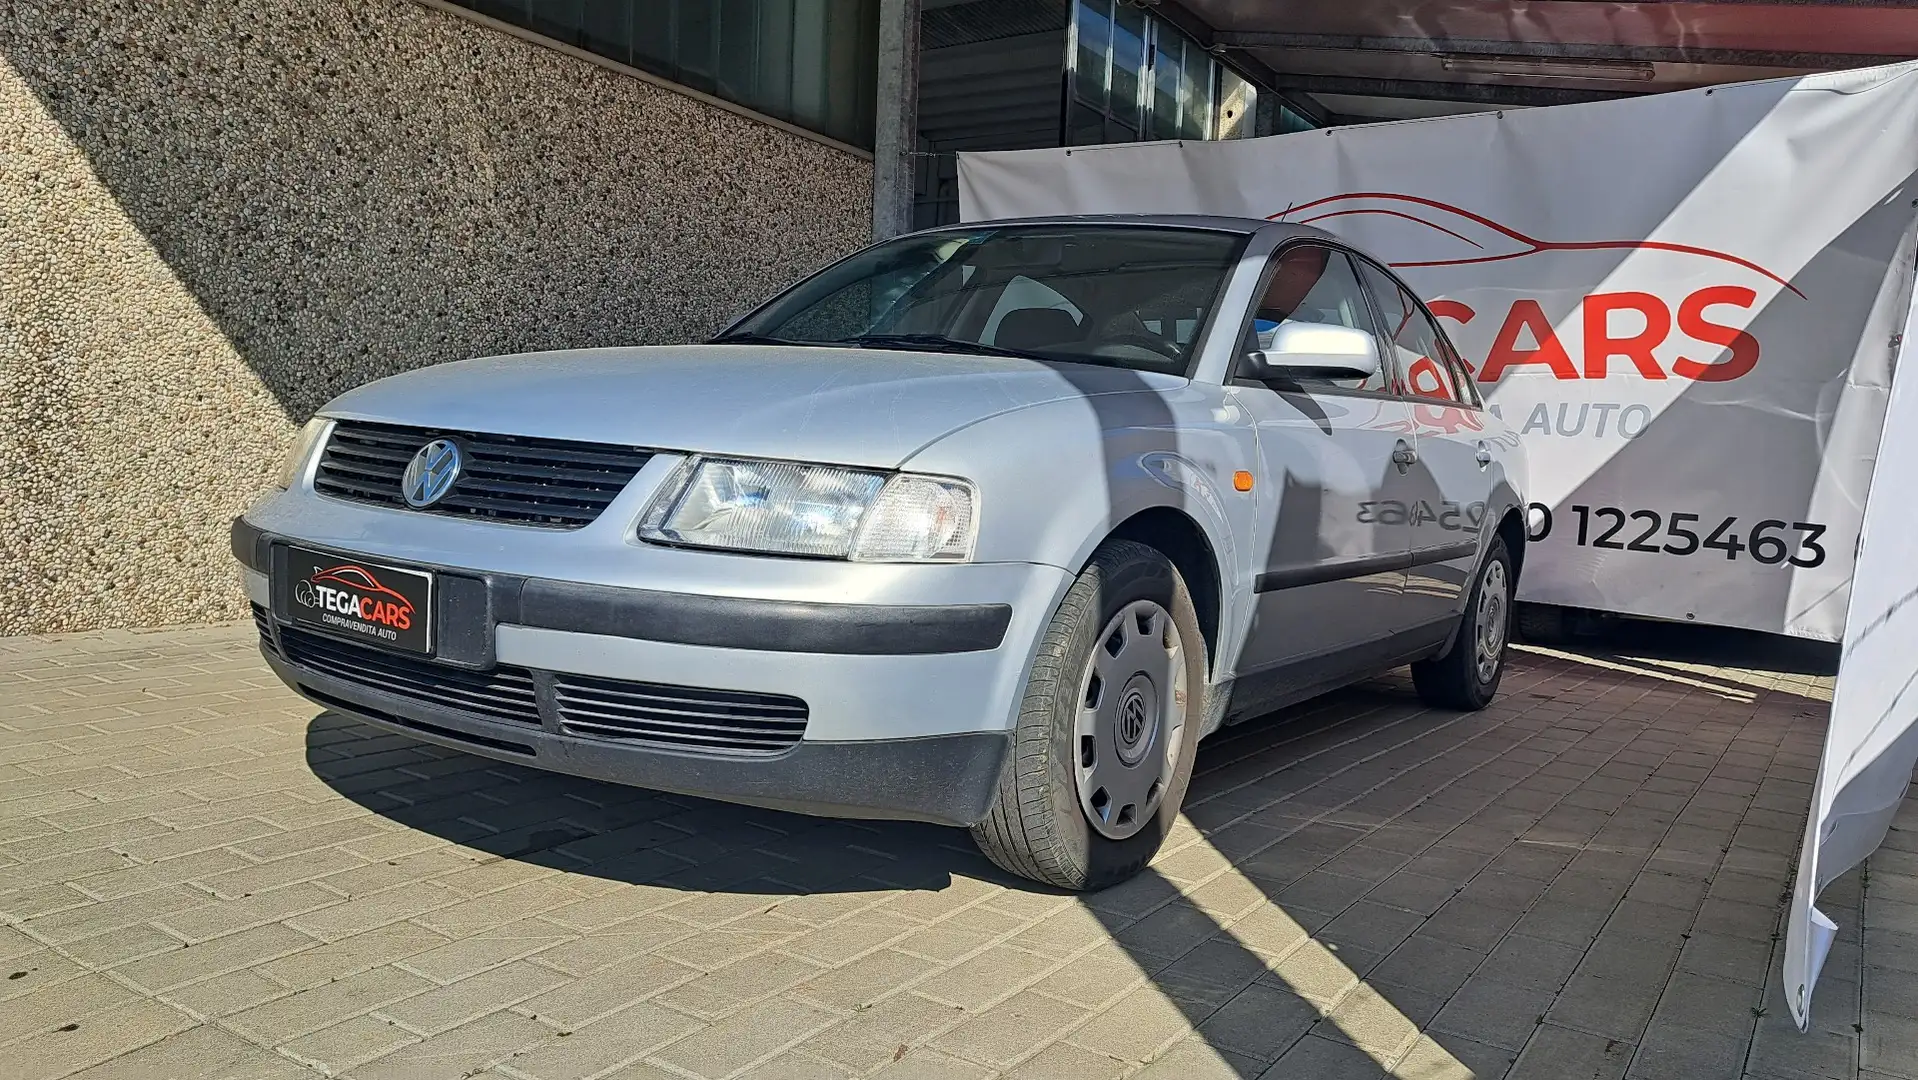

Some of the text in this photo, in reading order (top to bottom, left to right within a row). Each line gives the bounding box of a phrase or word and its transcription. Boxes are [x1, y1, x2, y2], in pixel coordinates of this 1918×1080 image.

[1521, 402, 1652, 439] AUTO
[1571, 505, 1828, 568] 1225463
[316, 585, 411, 630] TEGACARS
[322, 613, 397, 640] COMPRAVENDITA AUTO
